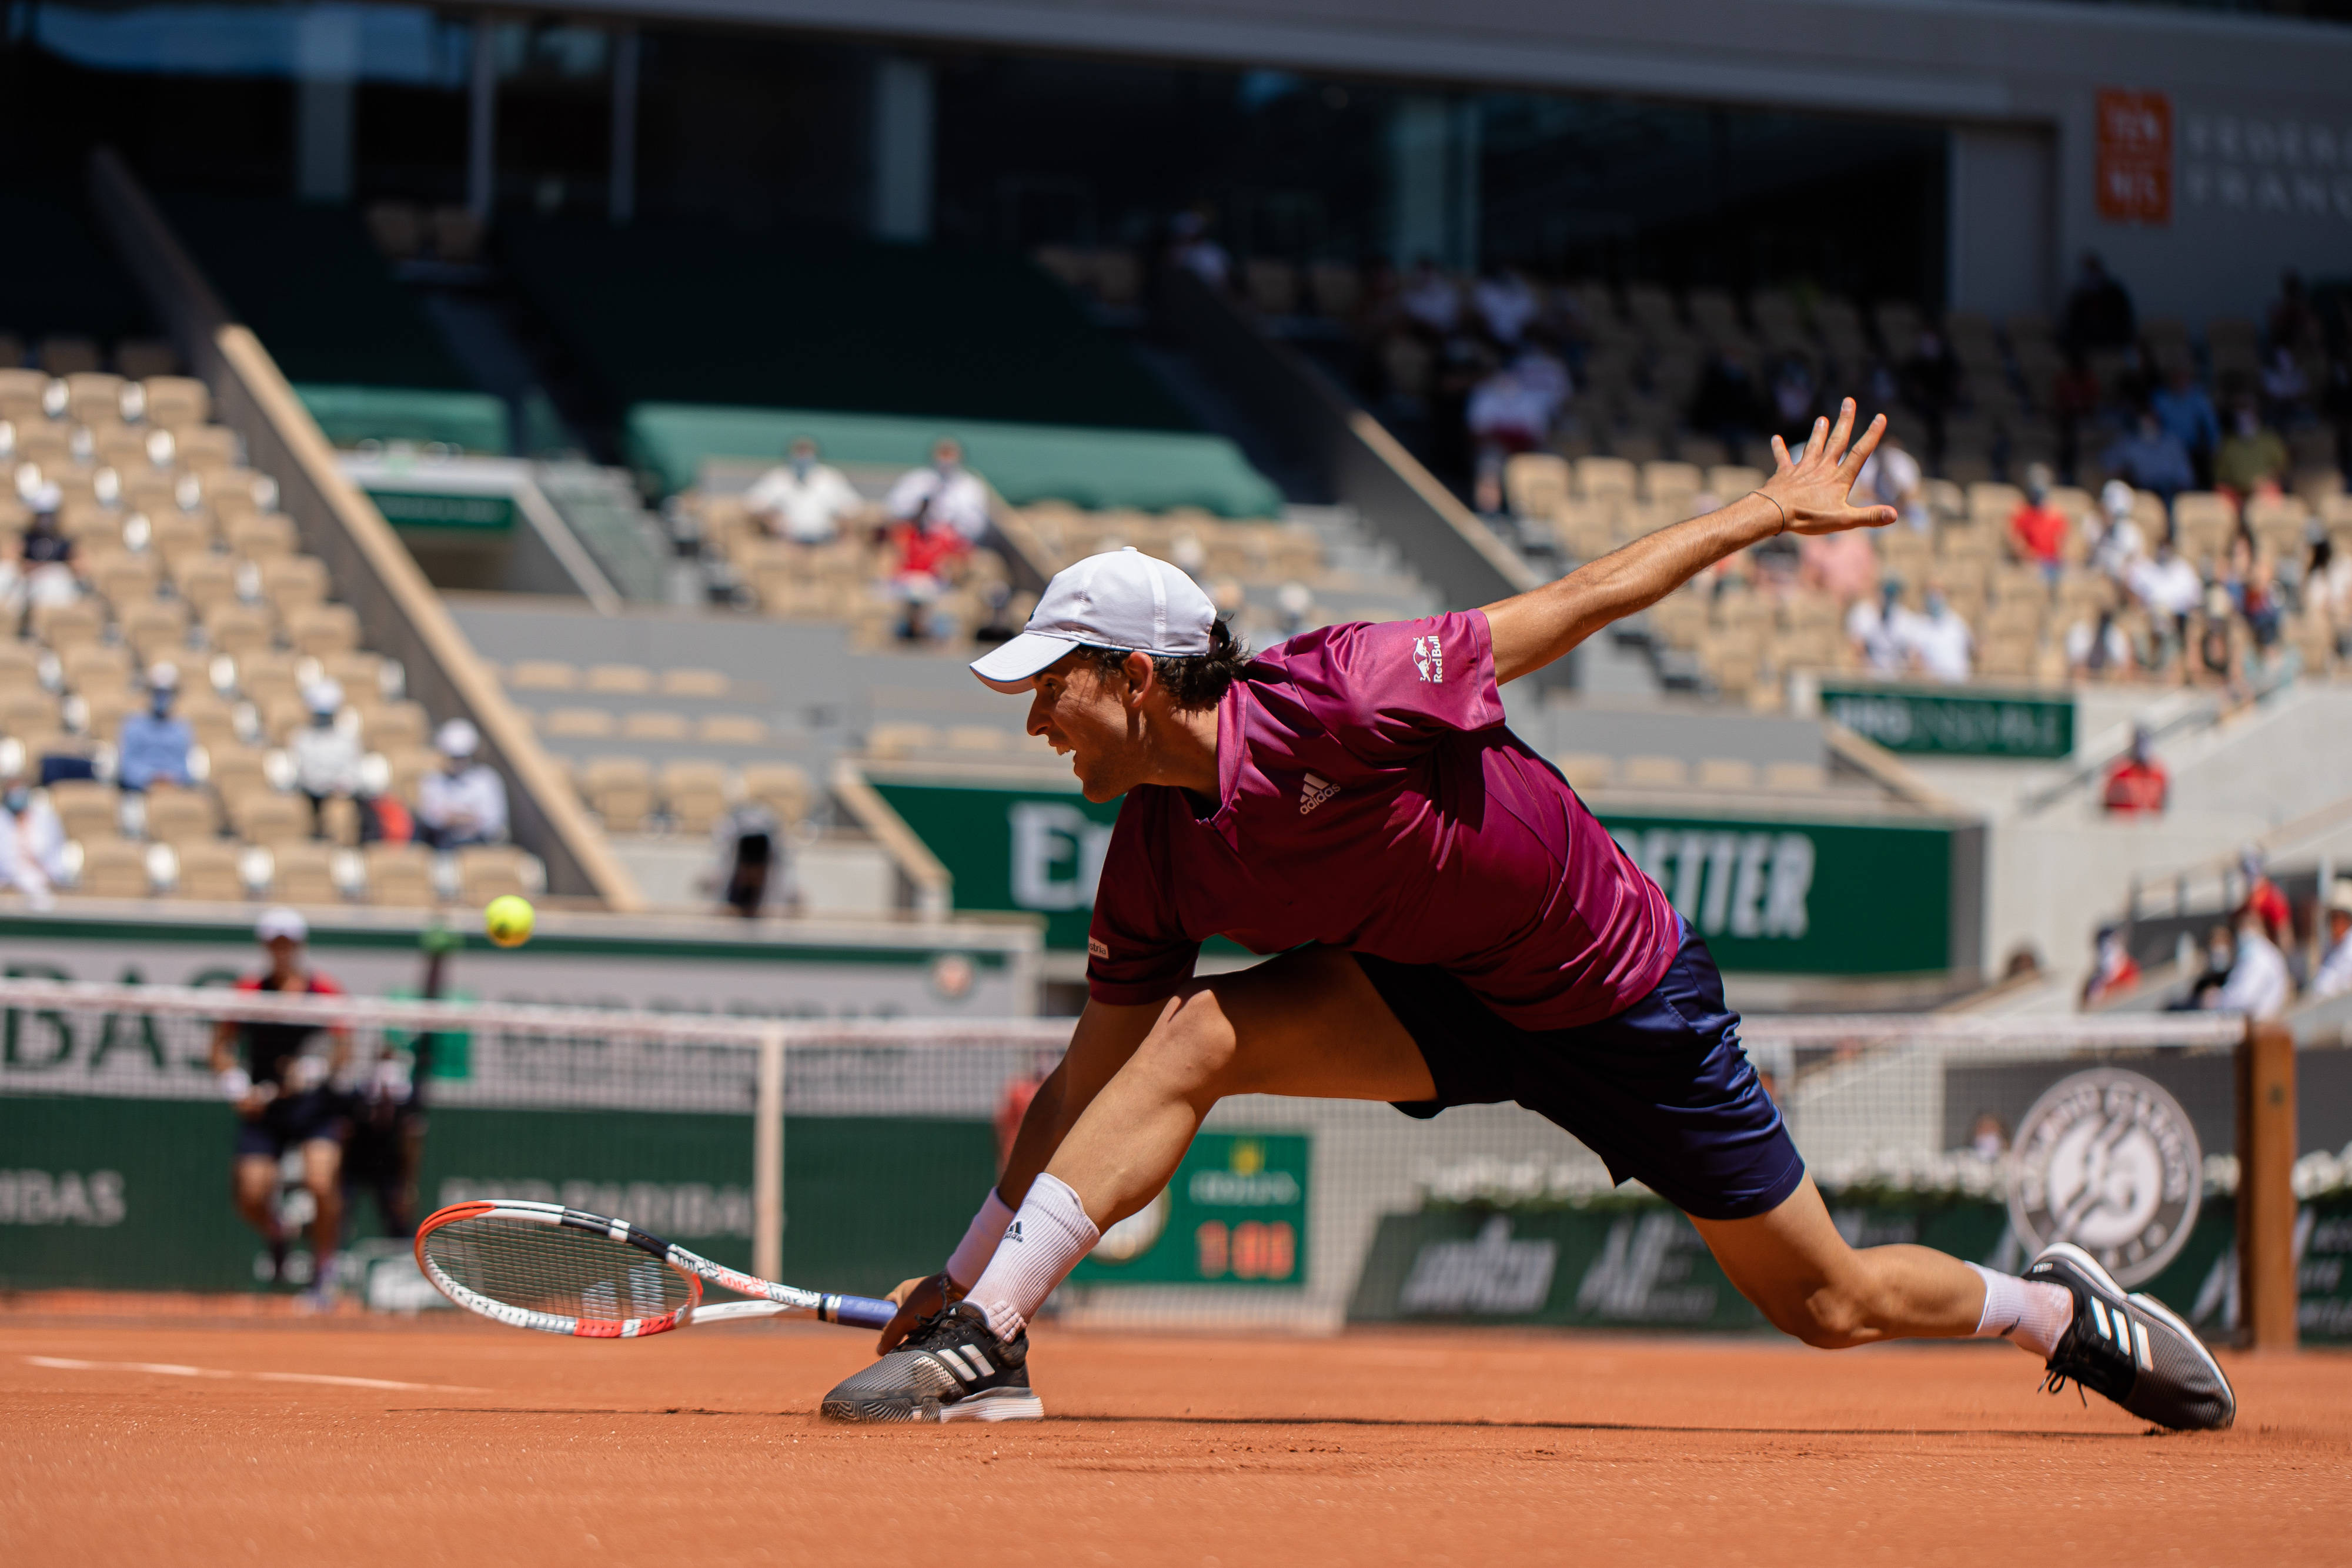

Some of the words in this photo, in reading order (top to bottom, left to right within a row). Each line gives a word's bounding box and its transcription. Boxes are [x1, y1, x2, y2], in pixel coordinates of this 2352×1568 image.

[1427, 636, 1442, 658] Bull
[1432, 658, 1443, 683] Red
[1299, 784, 1341, 814] adidas
[1088, 942, 1107, 955] stria
